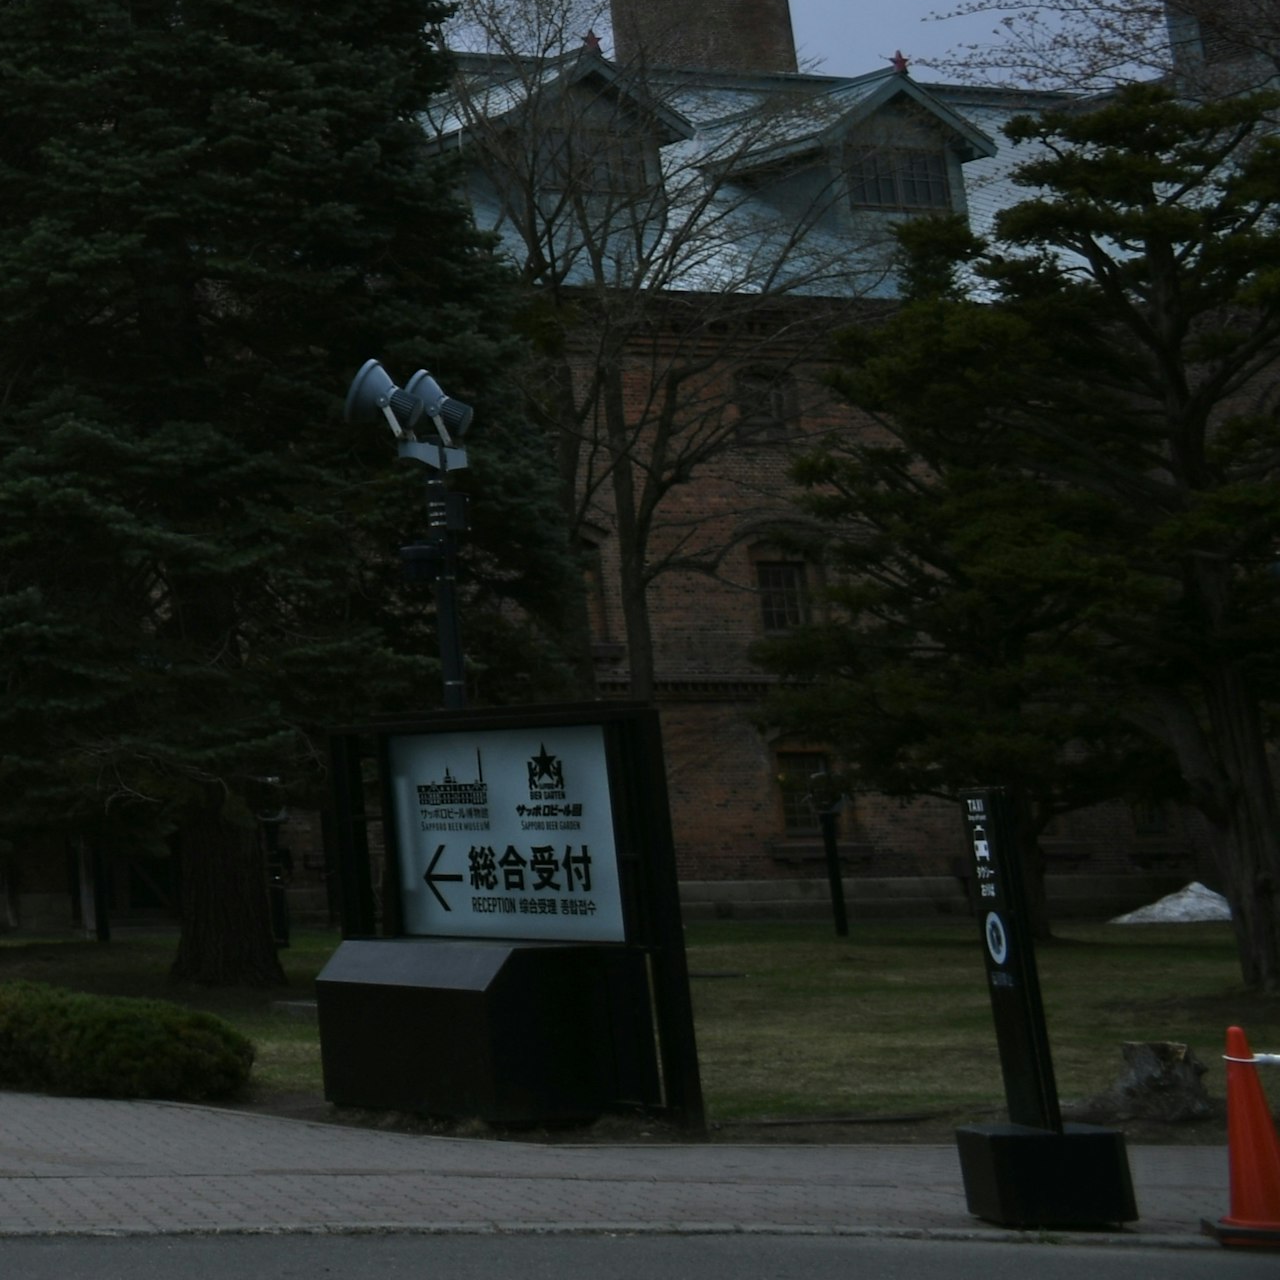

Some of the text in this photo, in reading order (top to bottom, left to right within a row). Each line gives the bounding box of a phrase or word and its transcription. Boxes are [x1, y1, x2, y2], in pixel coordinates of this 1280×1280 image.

[468, 844, 592, 891] 総合受付
[471, 897, 516, 913] RECEPTION
